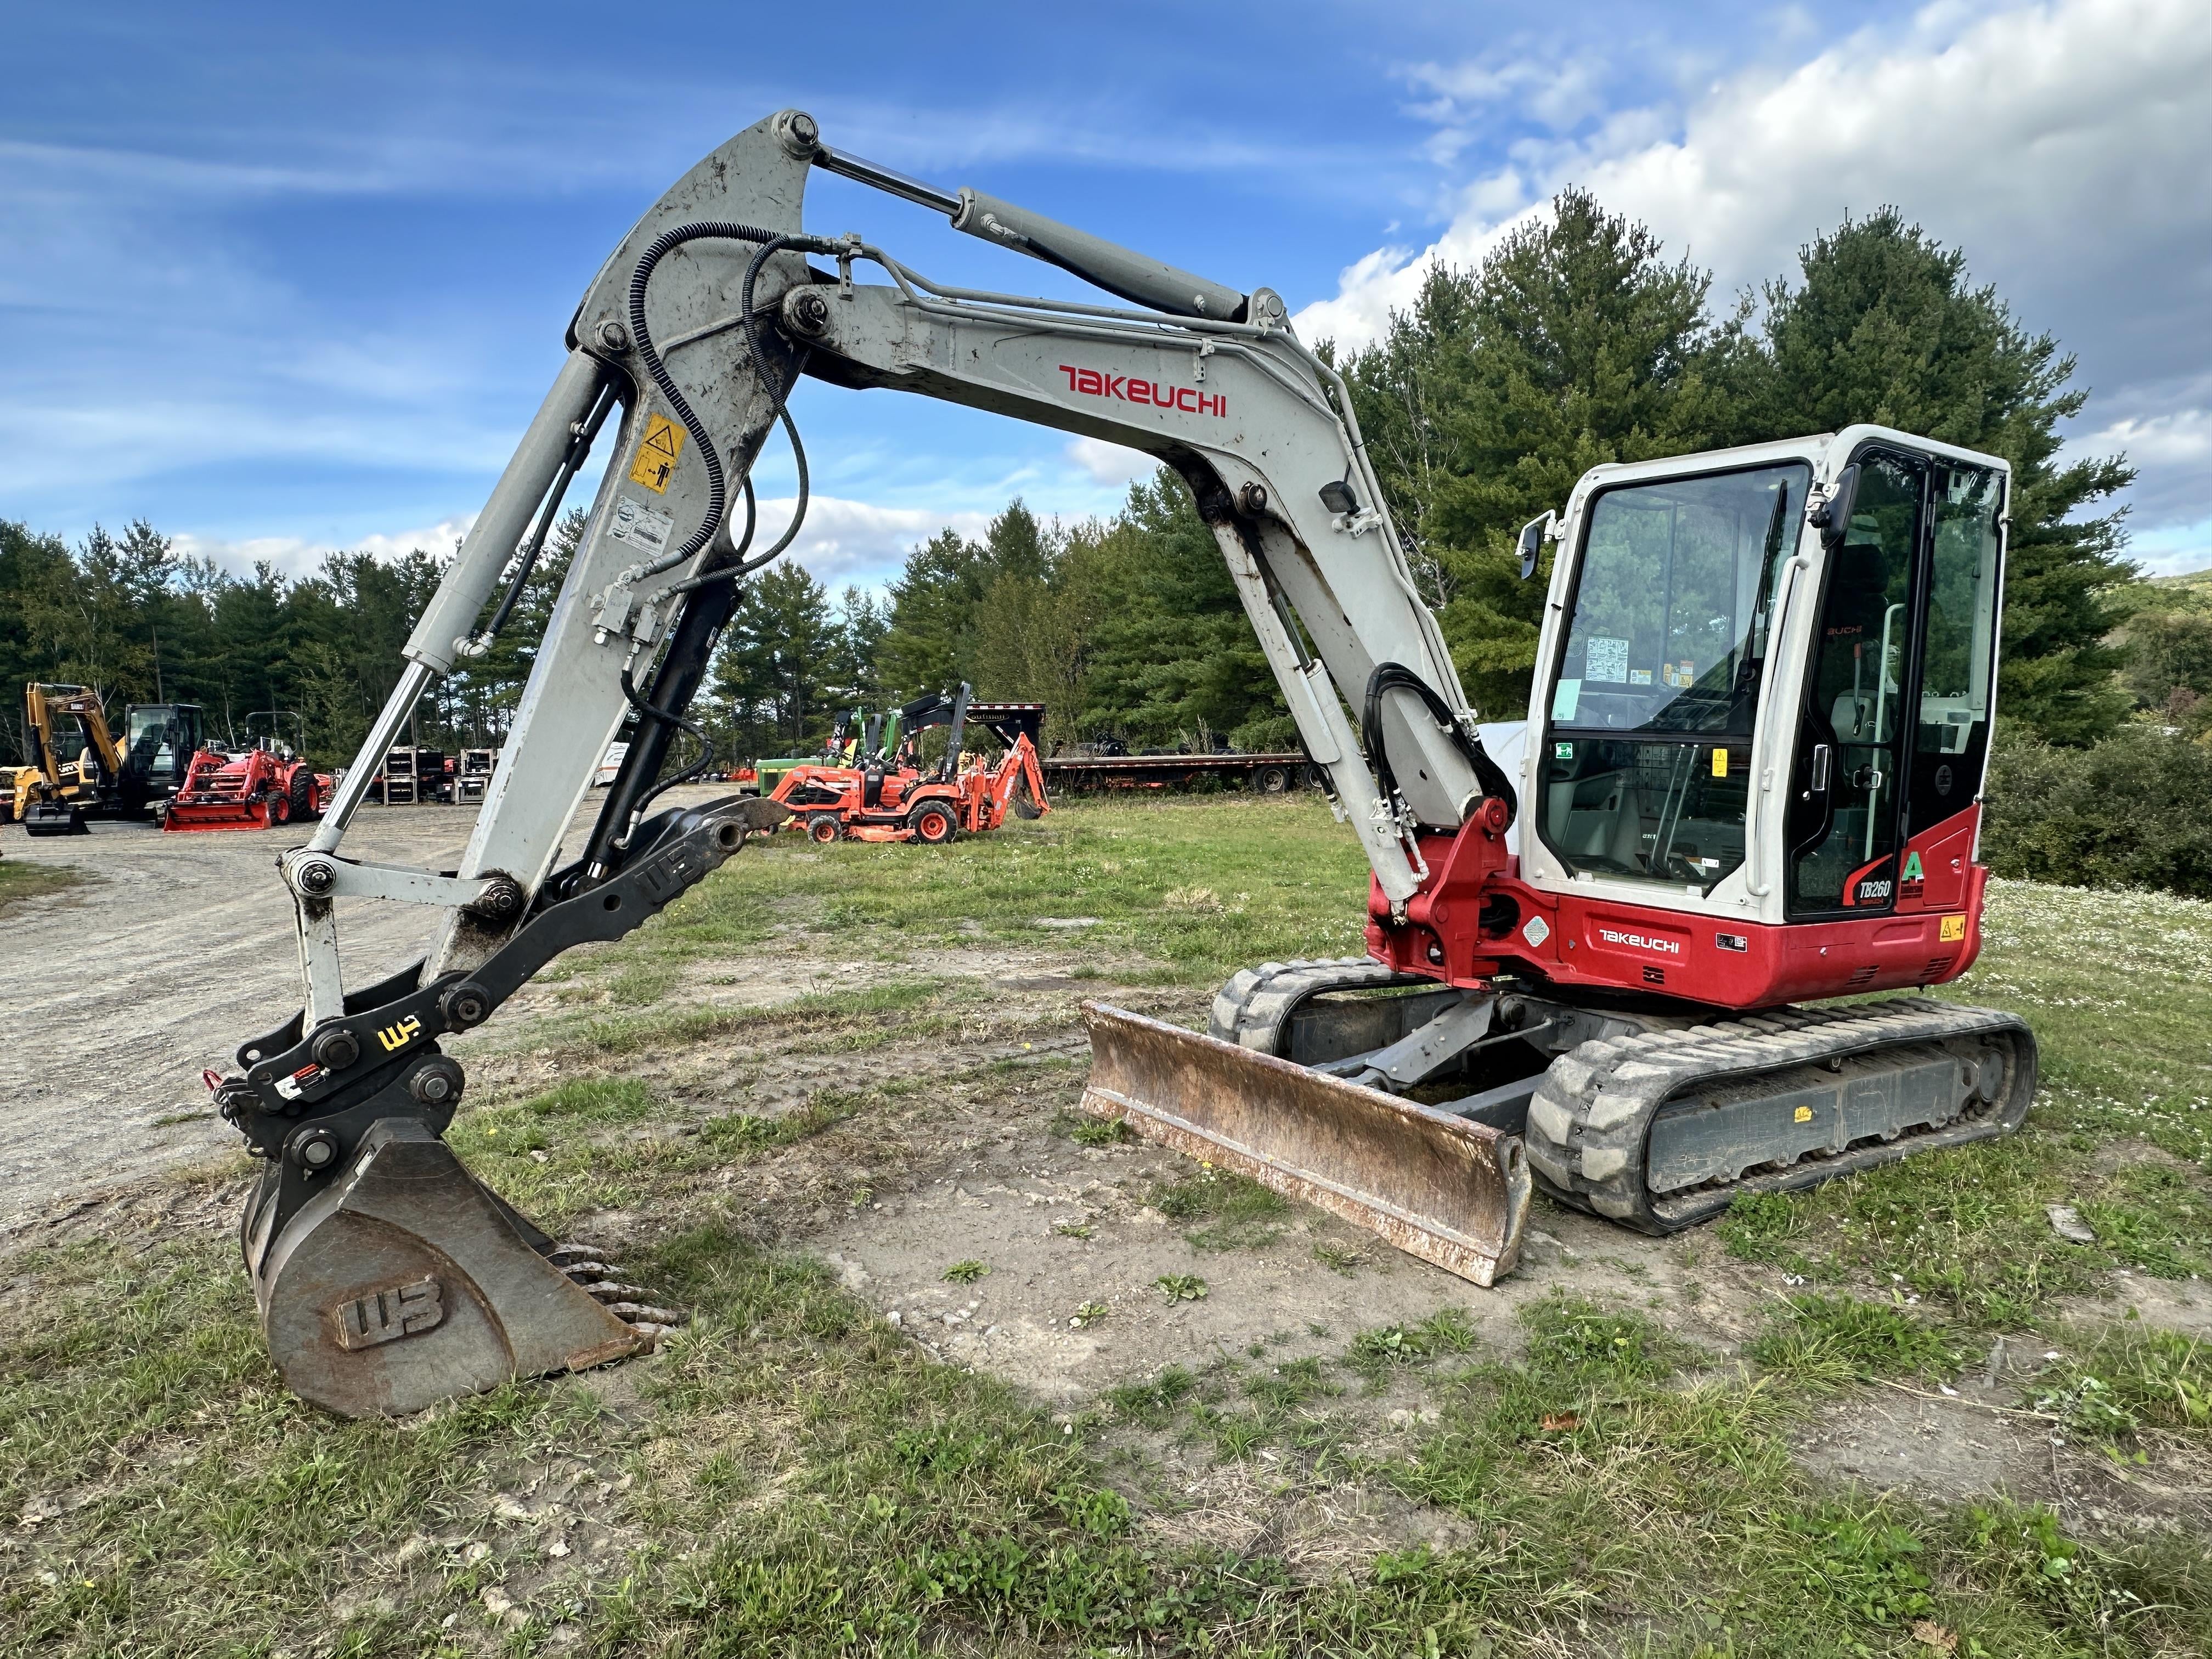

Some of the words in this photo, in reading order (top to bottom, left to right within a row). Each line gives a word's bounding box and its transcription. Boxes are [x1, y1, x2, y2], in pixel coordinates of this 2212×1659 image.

[1059, 365, 1226, 418] TAKEUCHI
[1860, 881, 1891, 898] TB260
[1599, 929, 1679, 953] TAKEUCHI
